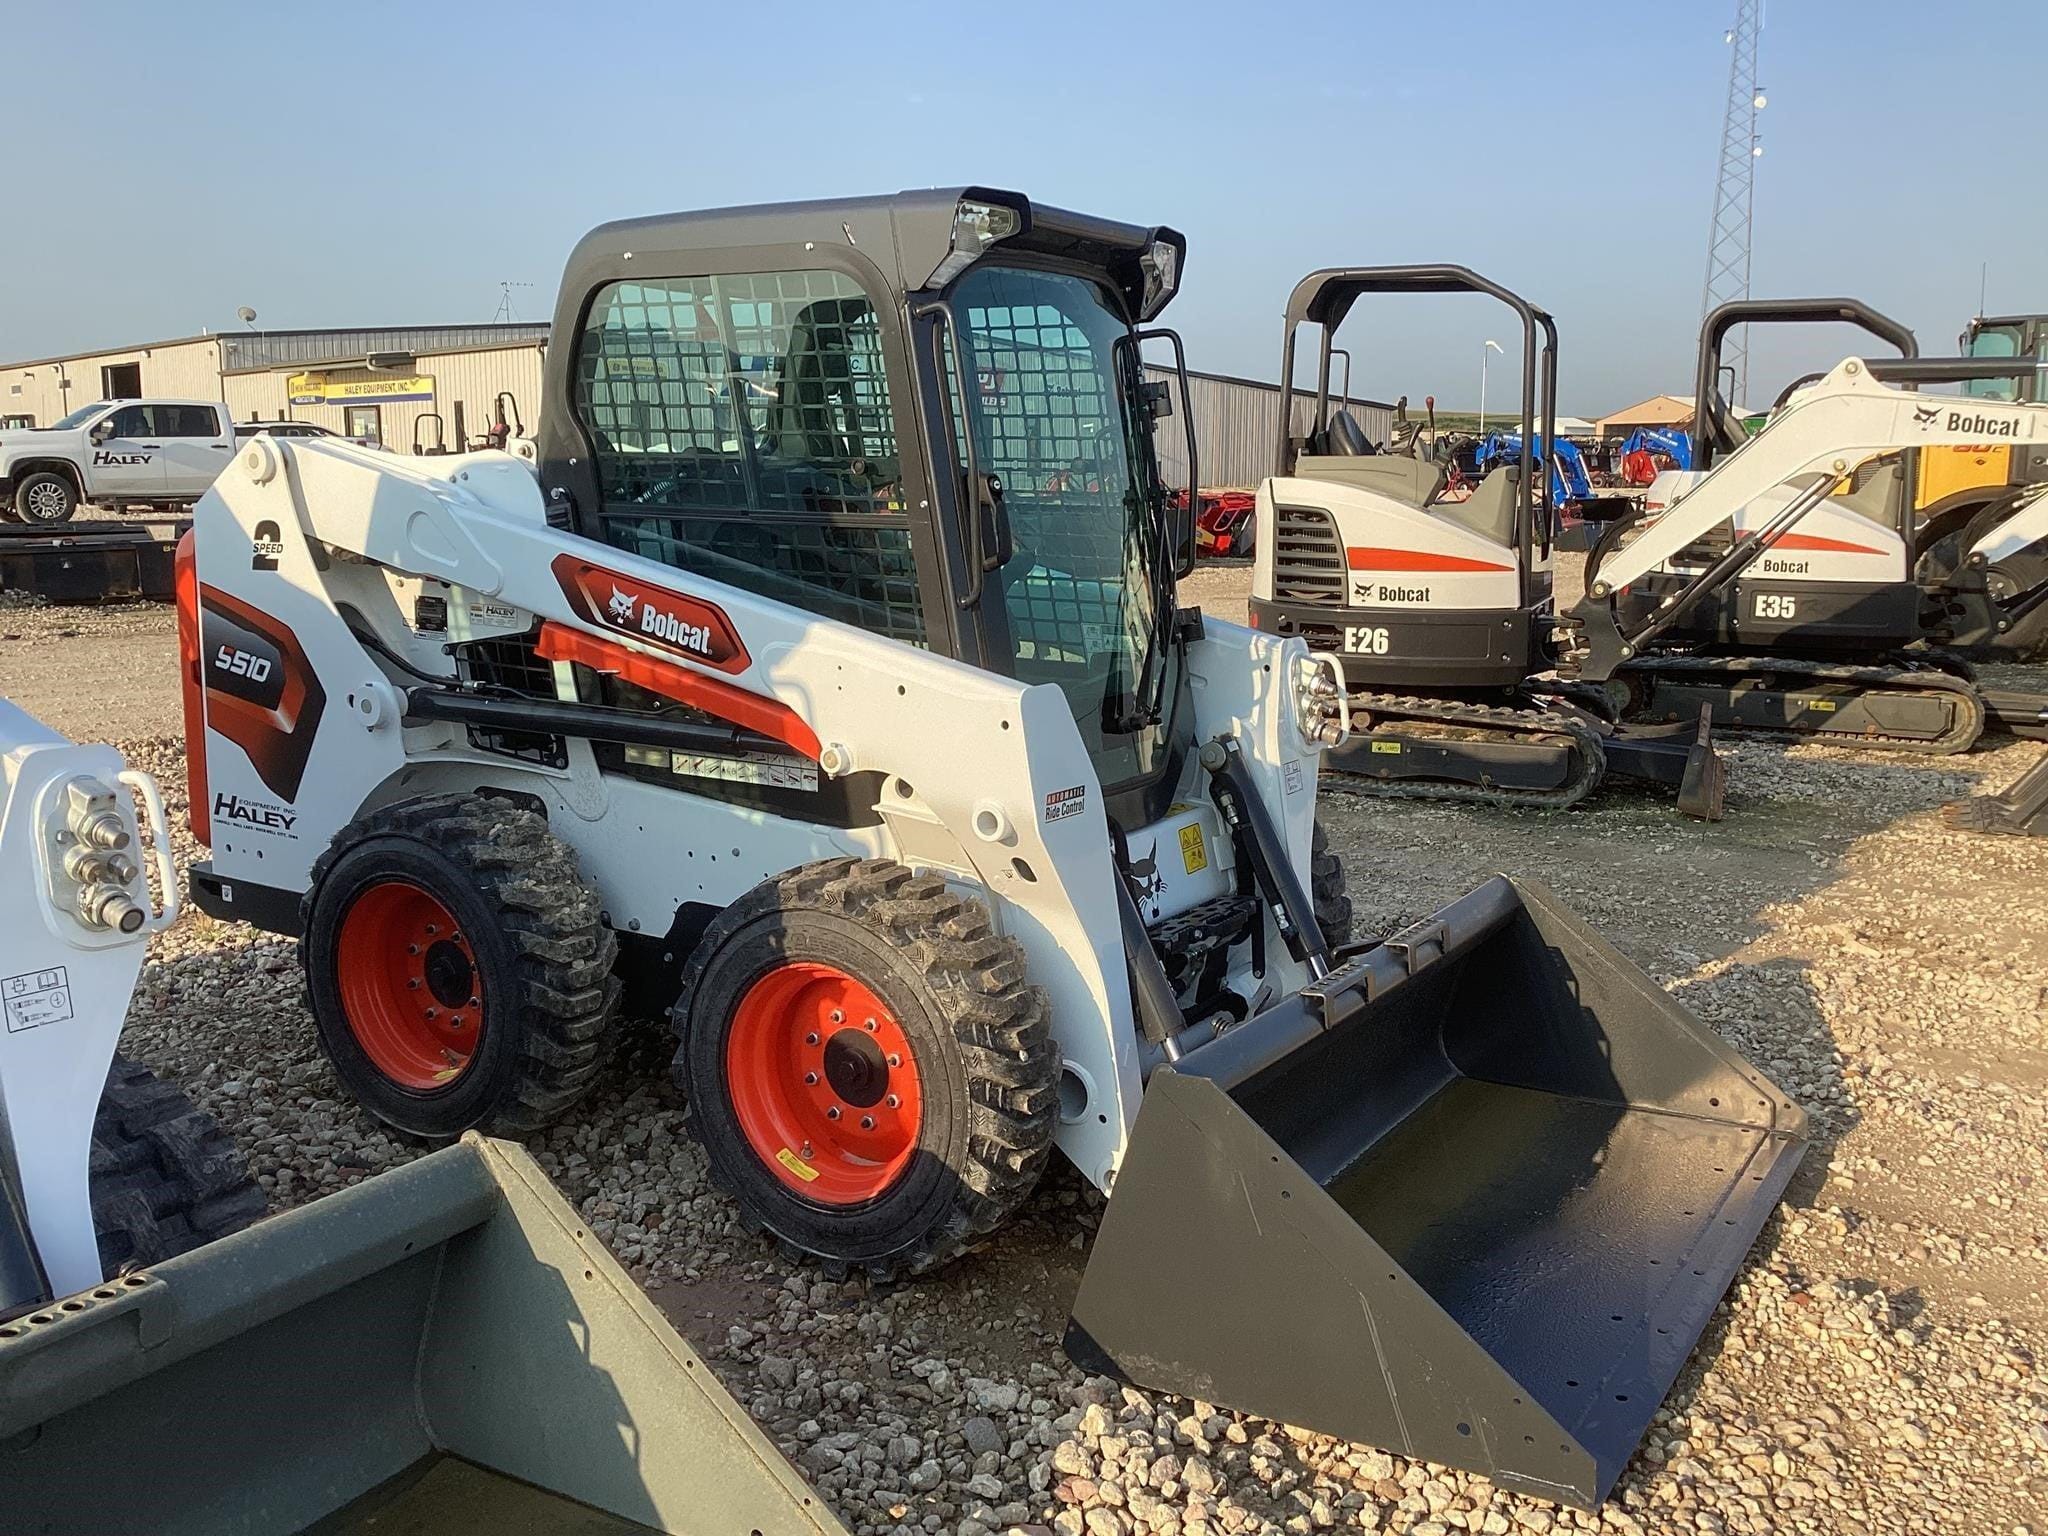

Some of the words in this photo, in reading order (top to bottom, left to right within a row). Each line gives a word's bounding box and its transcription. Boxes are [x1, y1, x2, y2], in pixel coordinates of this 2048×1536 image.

[344, 385, 362, 395] HALEY
[1946, 412, 2020, 437] Bobcat
[93, 451, 152, 465] HALEY
[252, 543, 283, 554] SPEED
[1763, 559, 1809, 574] Bobcat
[1379, 586, 1430, 602] Bobcat
[1755, 595, 1796, 619] E35
[641, 603, 710, 654] Bobcat
[1344, 627, 1389, 655] E26
[215, 645, 271, 682] S510
[239, 799, 280, 812] EQUIPMENT
[1047, 787, 1084, 804] AUTOMATIC
[214, 792, 297, 831] HALEY
[1045, 805, 1060, 821] Ride
[1061, 797, 1085, 816] Control
